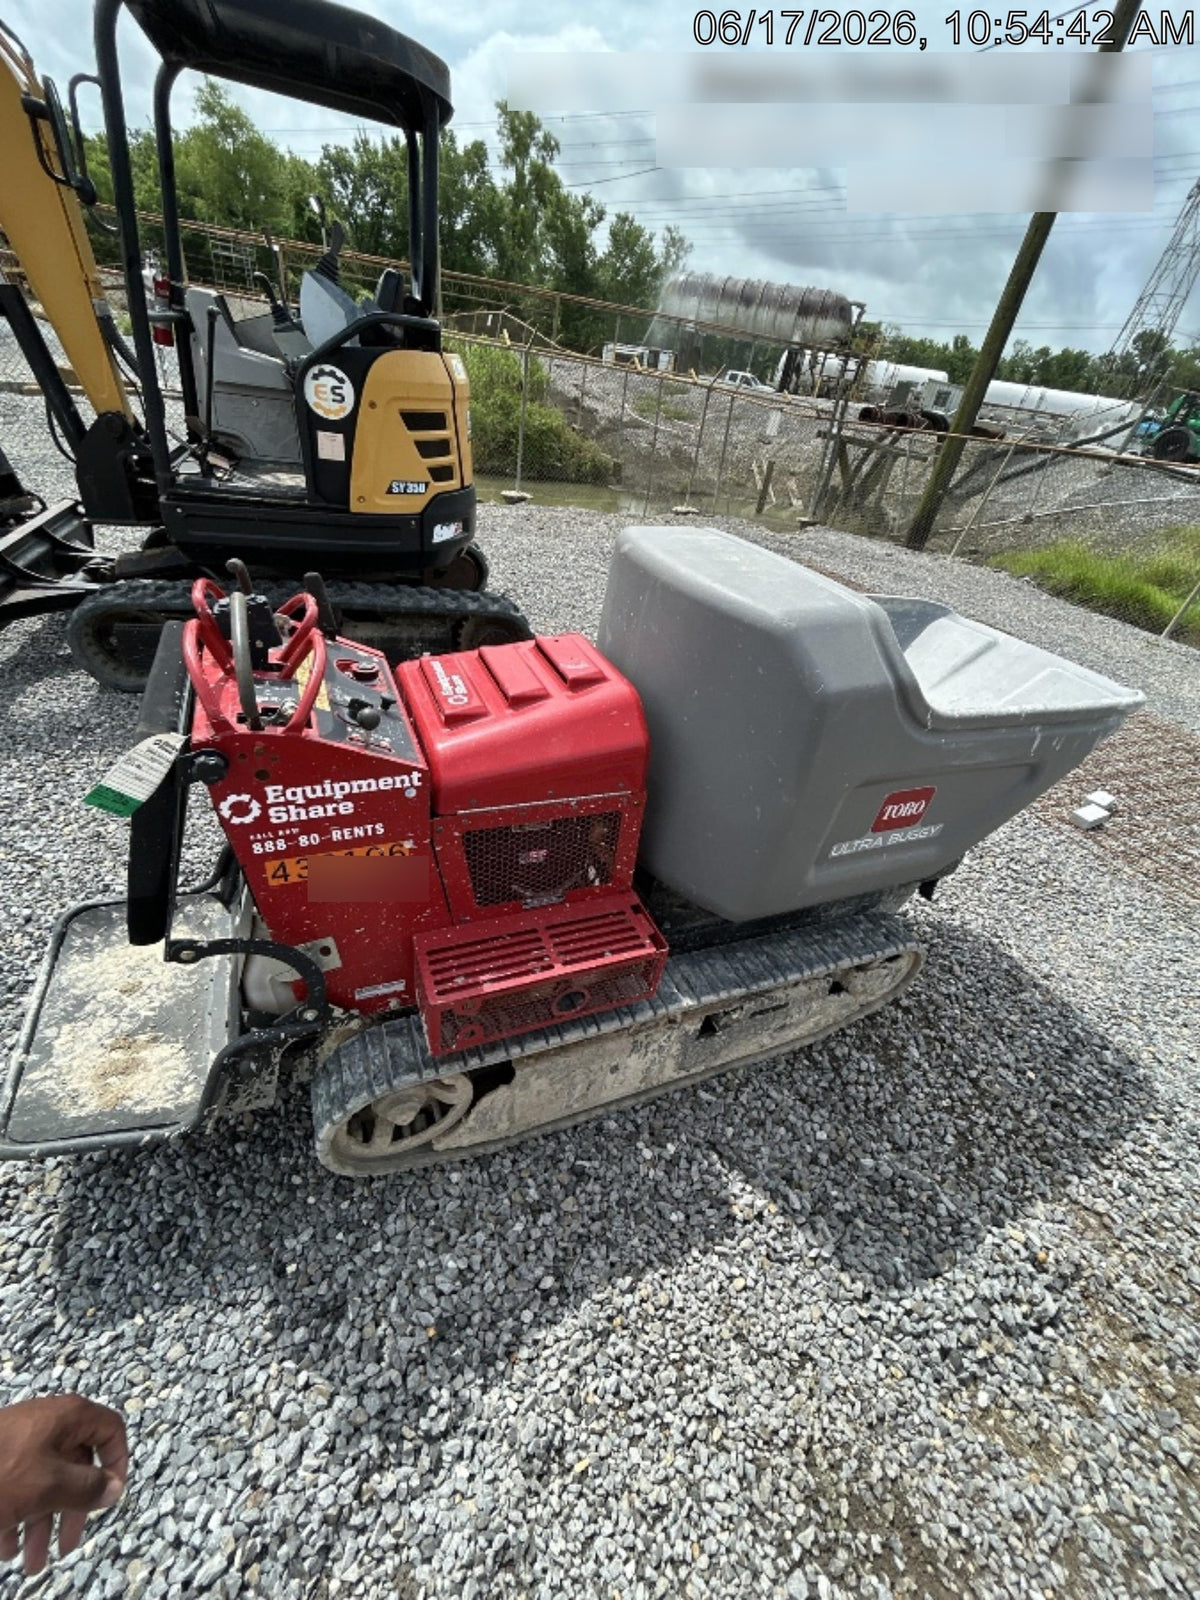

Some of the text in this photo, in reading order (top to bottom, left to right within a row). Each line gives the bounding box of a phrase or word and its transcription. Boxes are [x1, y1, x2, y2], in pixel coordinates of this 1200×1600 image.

[314, 383, 346, 404] ES
[264, 771, 422, 804] Equipment
[268, 801, 355, 824] Share
[882, 800, 926, 820] TORO
[252, 823, 385, 854] 888-80-RENTS
[830, 824, 944, 856] ULTRA BUGGY
